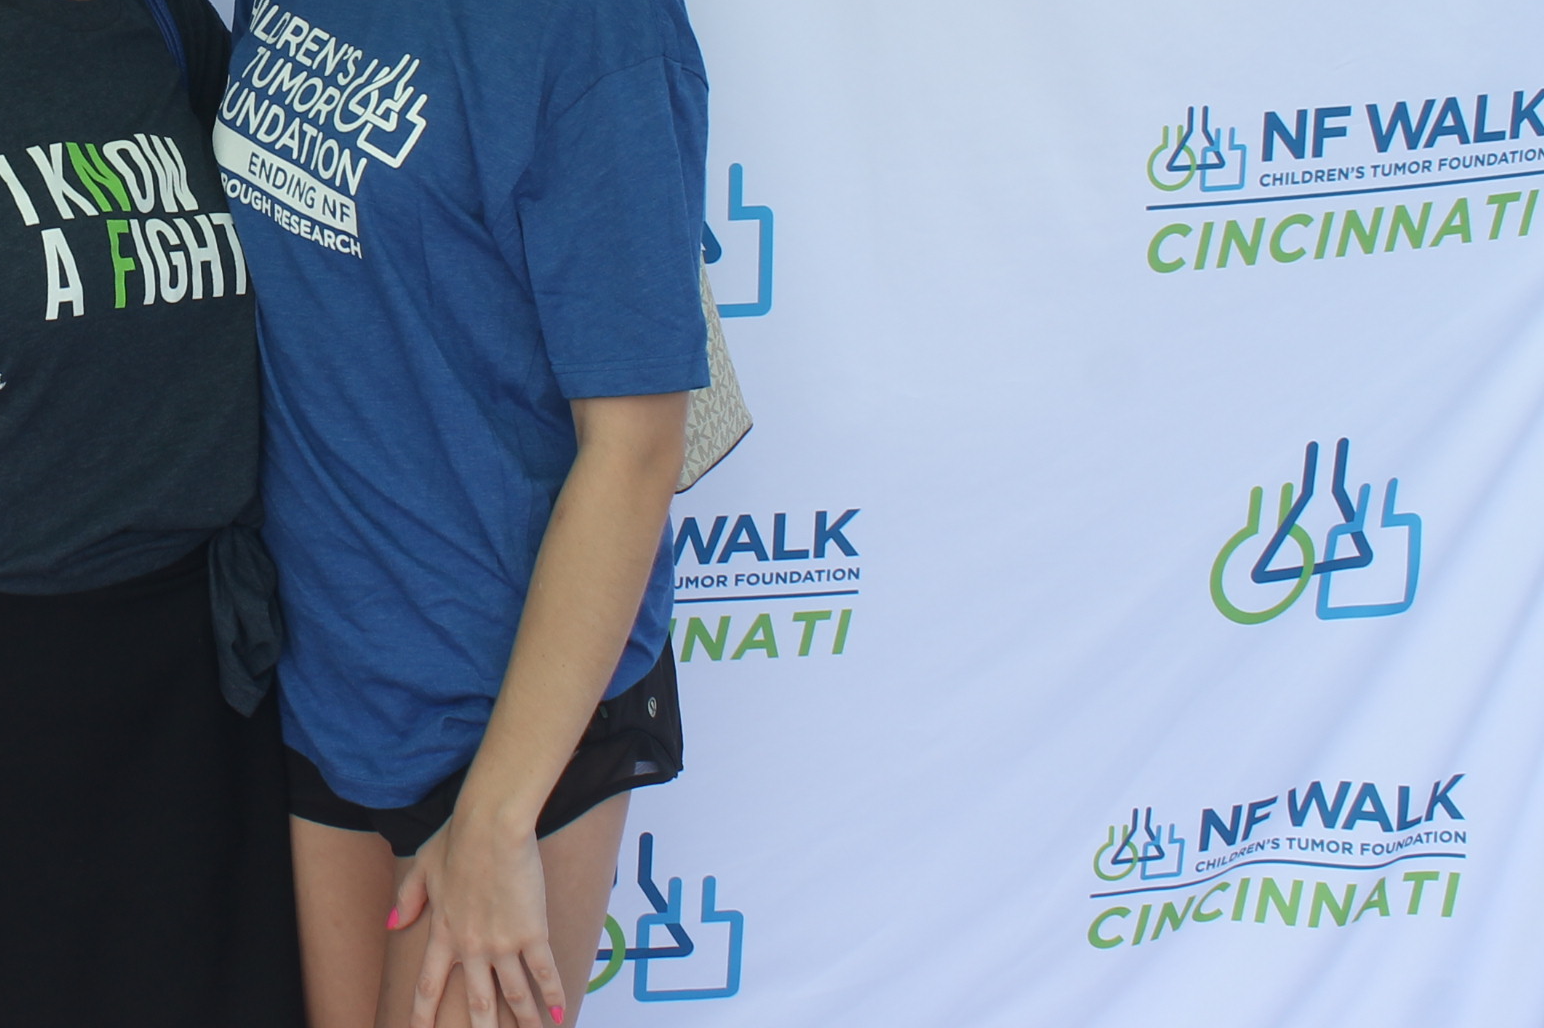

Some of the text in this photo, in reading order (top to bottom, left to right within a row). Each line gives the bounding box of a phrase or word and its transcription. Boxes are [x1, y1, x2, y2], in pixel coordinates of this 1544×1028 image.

[242, 46, 341, 124] TUMOR
[1261, 87, 1544, 162] NF WALK
[219, 74, 367, 196] UNDATION
[1259, 165, 1365, 187] CHILDREN'S
[1371, 160, 1432, 179] TUMOR
[26, 133, 199, 220] KNOW
[220, 172, 363, 259] ROUGH RESEARCH
[247, 151, 351, 224] ENDING NF
[1147, 189, 1540, 273] CINCINNATI
[41, 227, 85, 320] A
[674, 567, 860, 590] UMOR FOUNDATION
[1194, 830, 1467, 873] CHILDREN'S TUMOR FOUNDATION
[1198, 773, 1466, 852] NF WALK
[1087, 870, 1461, 949] CINCINNATI
